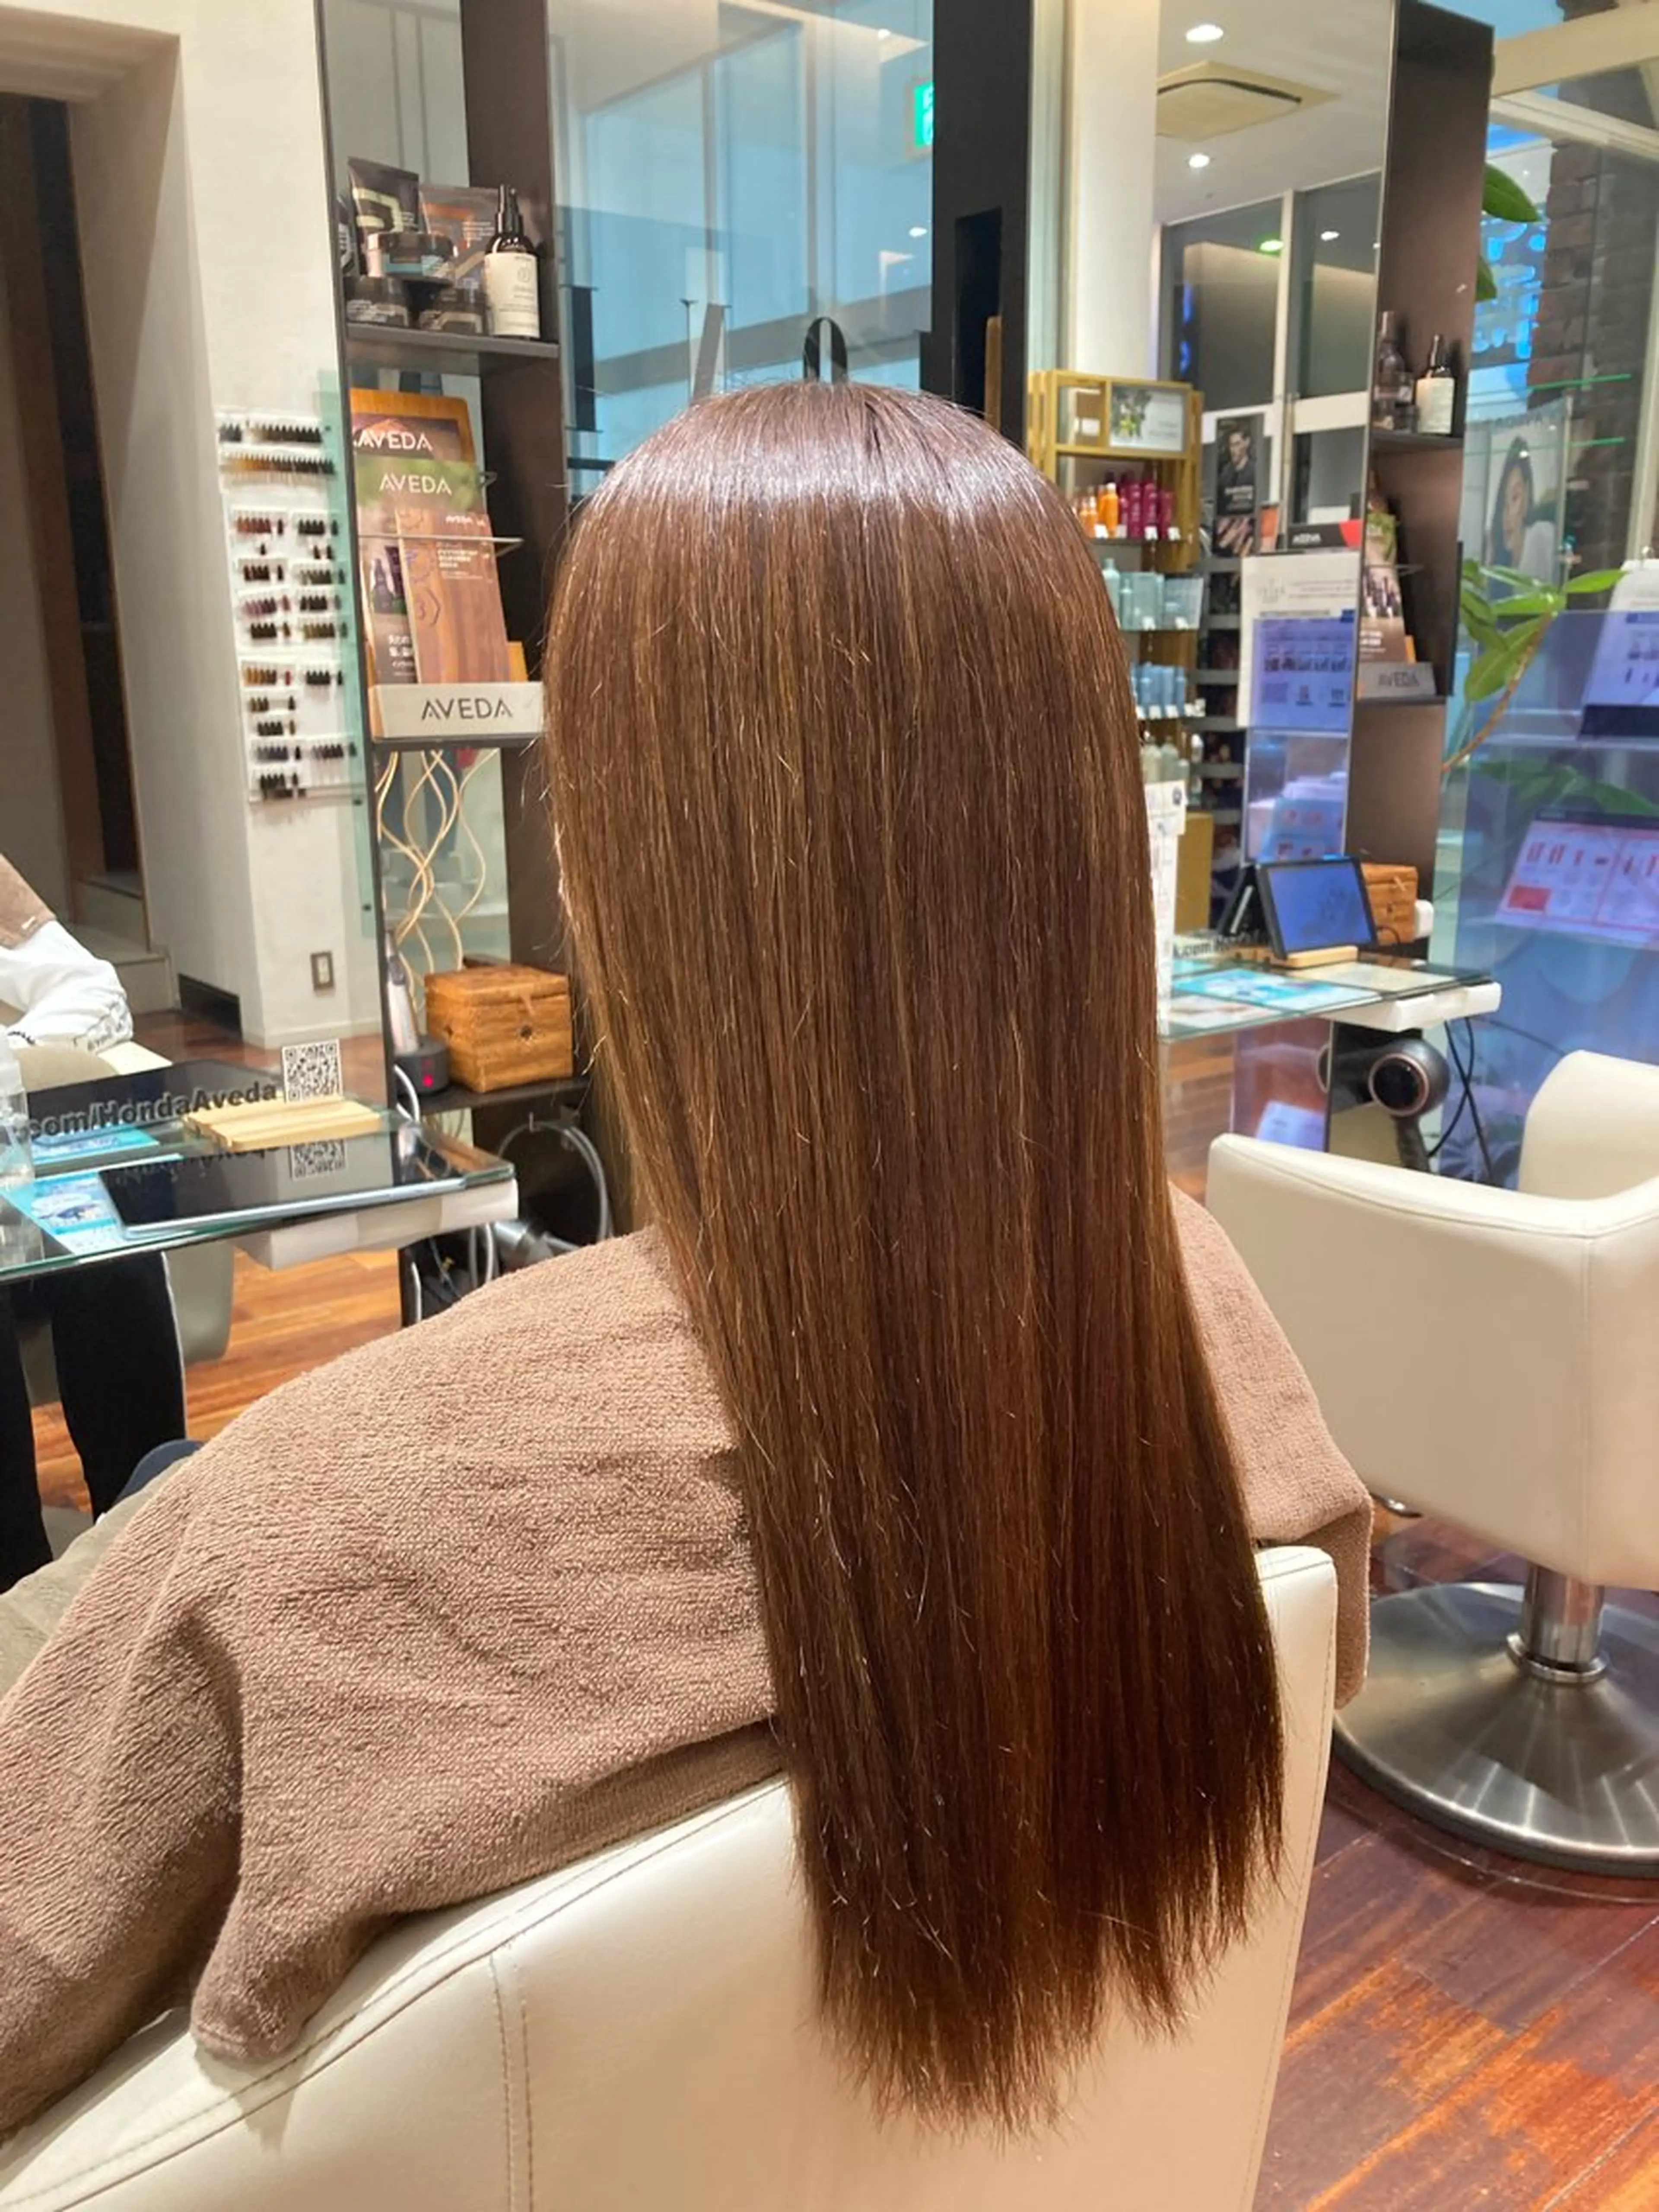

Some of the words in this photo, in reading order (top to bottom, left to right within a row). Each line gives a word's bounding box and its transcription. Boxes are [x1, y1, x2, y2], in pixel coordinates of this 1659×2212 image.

[356, 429, 433, 451] AVEDA
[379, 473, 452, 496] AVEDA
[422, 697, 512, 721] AVEDA
